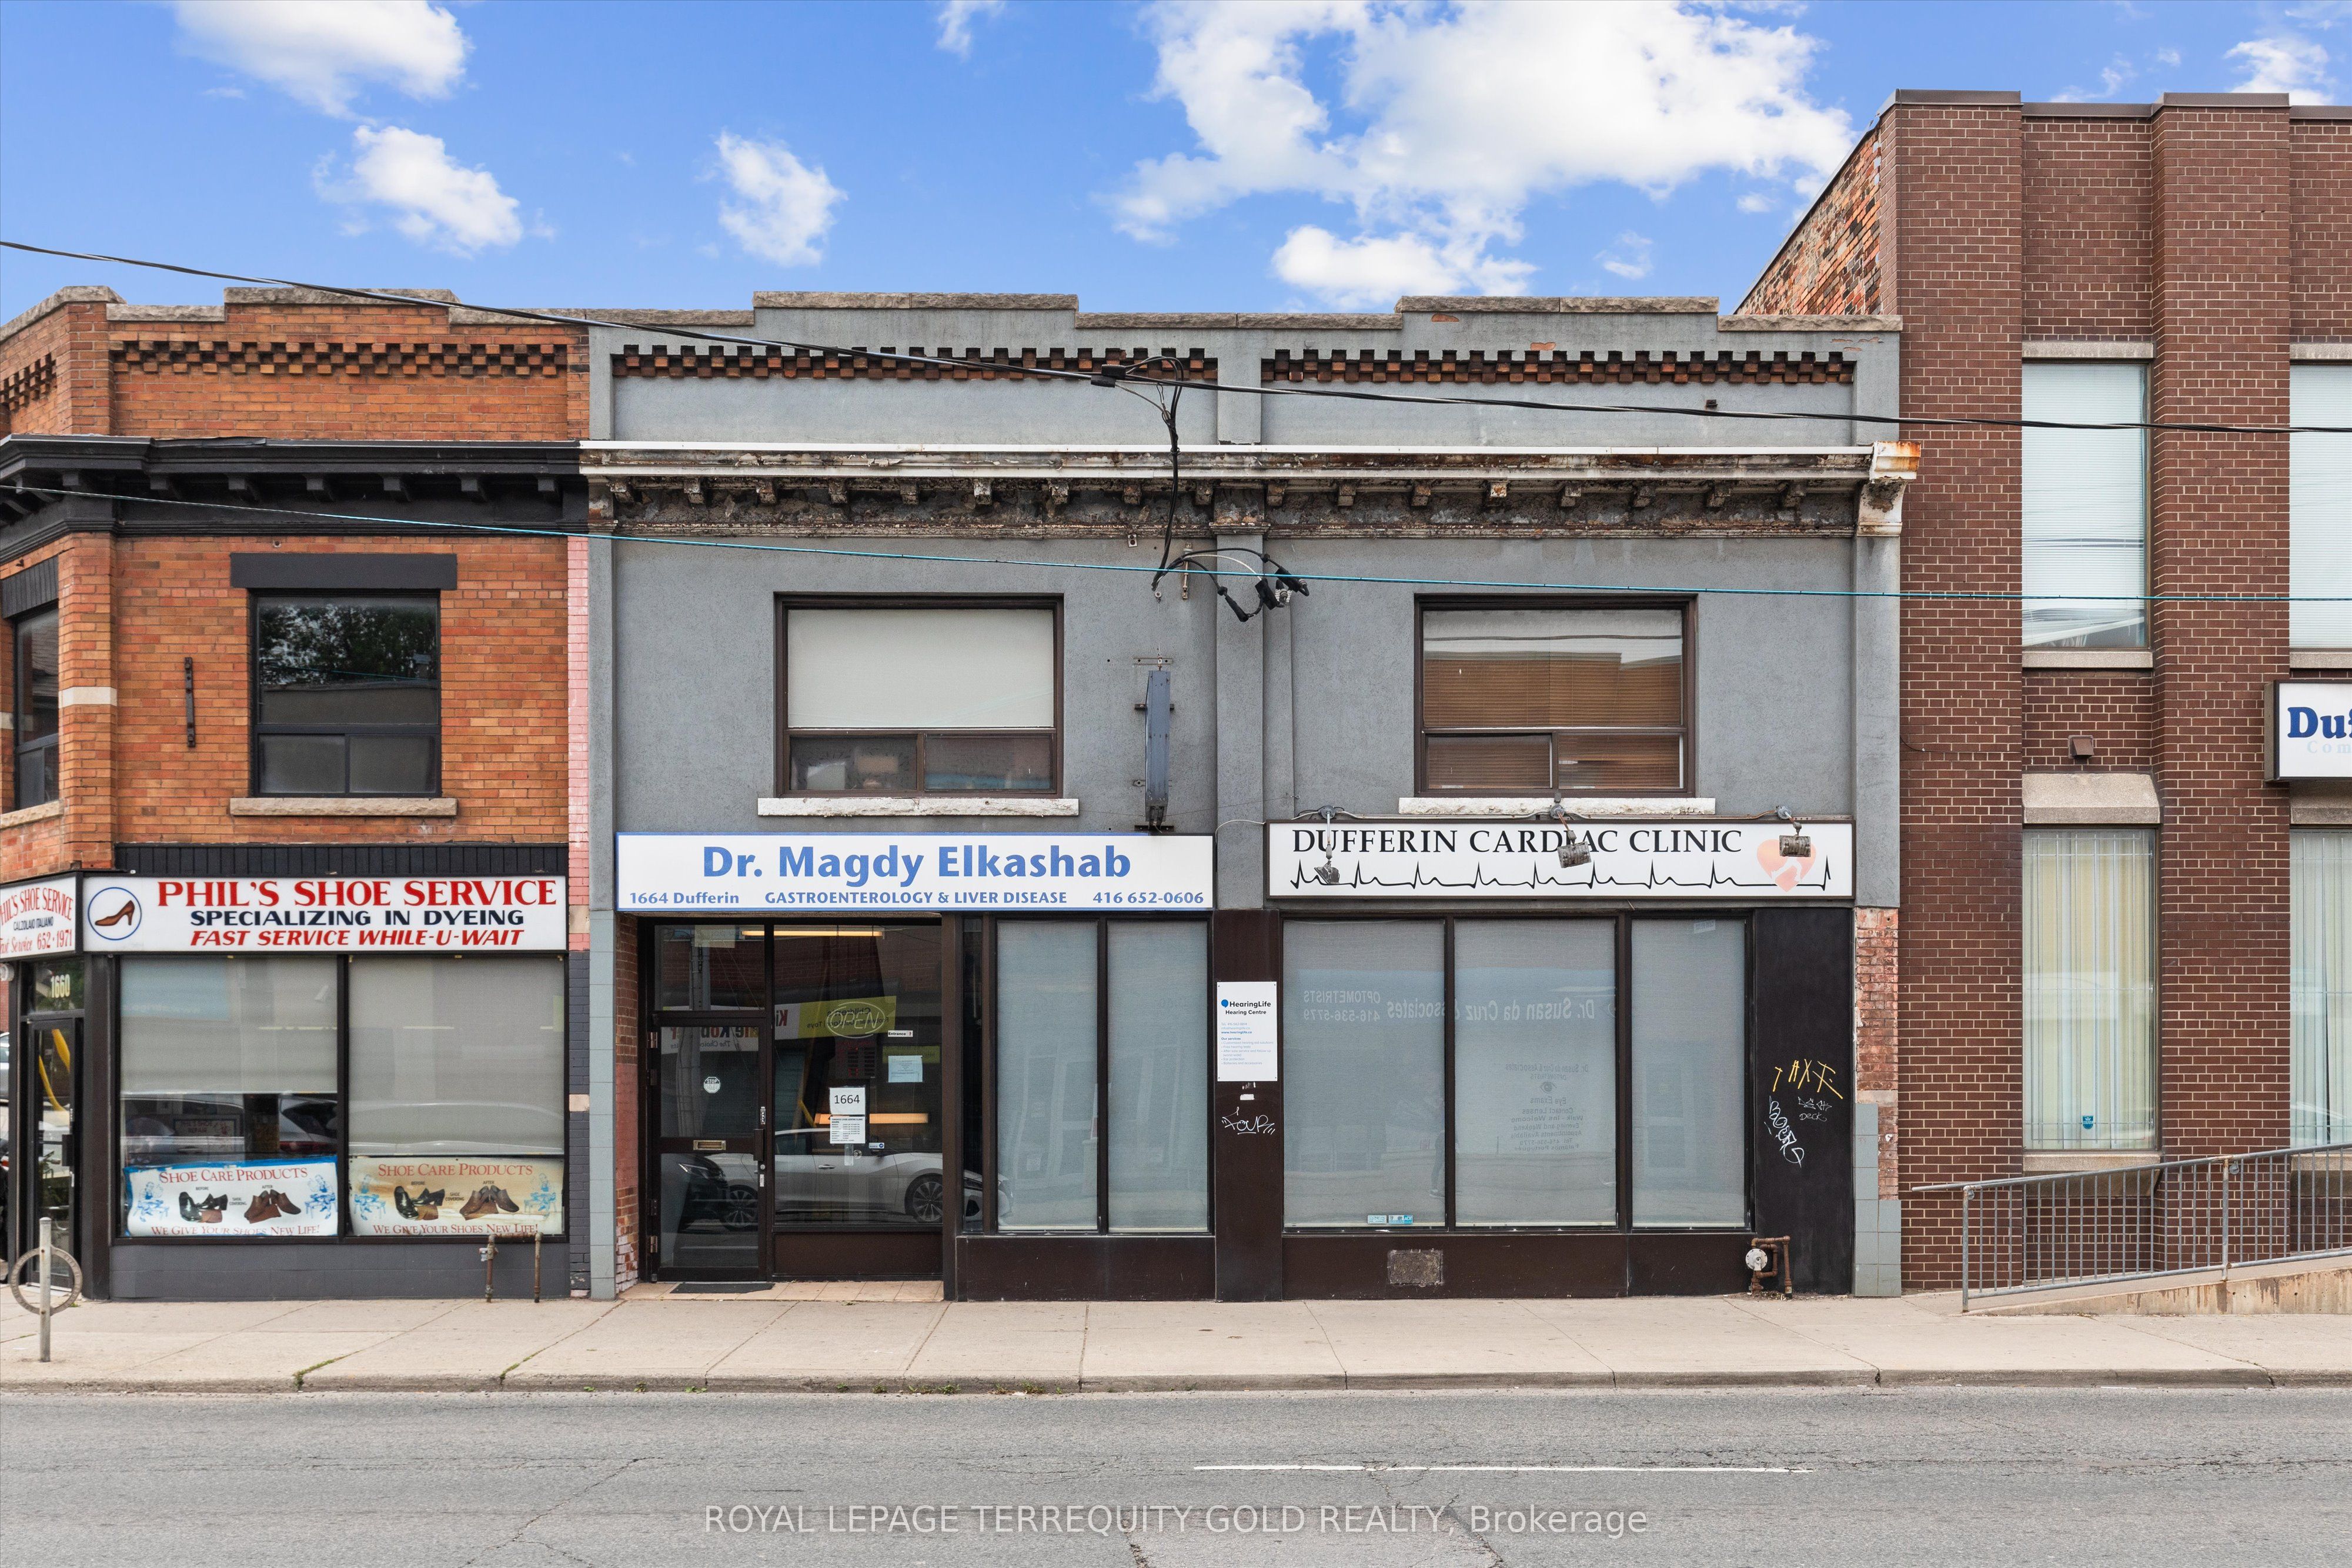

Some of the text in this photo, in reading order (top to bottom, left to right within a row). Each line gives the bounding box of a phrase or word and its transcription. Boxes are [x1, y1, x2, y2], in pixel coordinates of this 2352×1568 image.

[2287, 707, 2352, 739] Du
[1292, 830, 1457, 852] DUFFERIN
[1629, 830, 1742, 852] CLINIC
[704, 845, 1130, 887] Dr. Magdy Elkashab
[158, 880, 556, 907] PHIL'S SHOE SERVICE
[630, 891, 1204, 904] 1664 Dufferin GASTROENTEROLOGY & LIVER DISEASE 416 652-0606
[0, 887, 73, 925] HIL'S SHOE SERVICE
[36, 917, 54, 928] ITALIANO
[191, 910, 524, 926] SPECIALIZING IN DYEING
[11, 937, 32, 952] Service
[191, 930, 524, 945] FAST SERVICE WHILE-U-WAIT
[51, 974, 70, 998] 1660
[830, 1012, 880, 1029] OPEN
[834, 1095, 860, 1104] 1664
[159, 1168, 308, 1183] SHOE CARE PRODUCTS
[378, 1163, 533, 1176] SHOE CARE PRODUCTS
[151, 1226, 168, 1235] WE
[172, 1226, 197, 1235] GIVE
[199, 1226, 229, 1235] YOUR
[271, 1226, 293, 1235] NEW
[298, 1225, 320, 1234] LIFE!
[373, 1223, 538, 1234] WE GIVE YOUR SHOES NEW LIFE!
